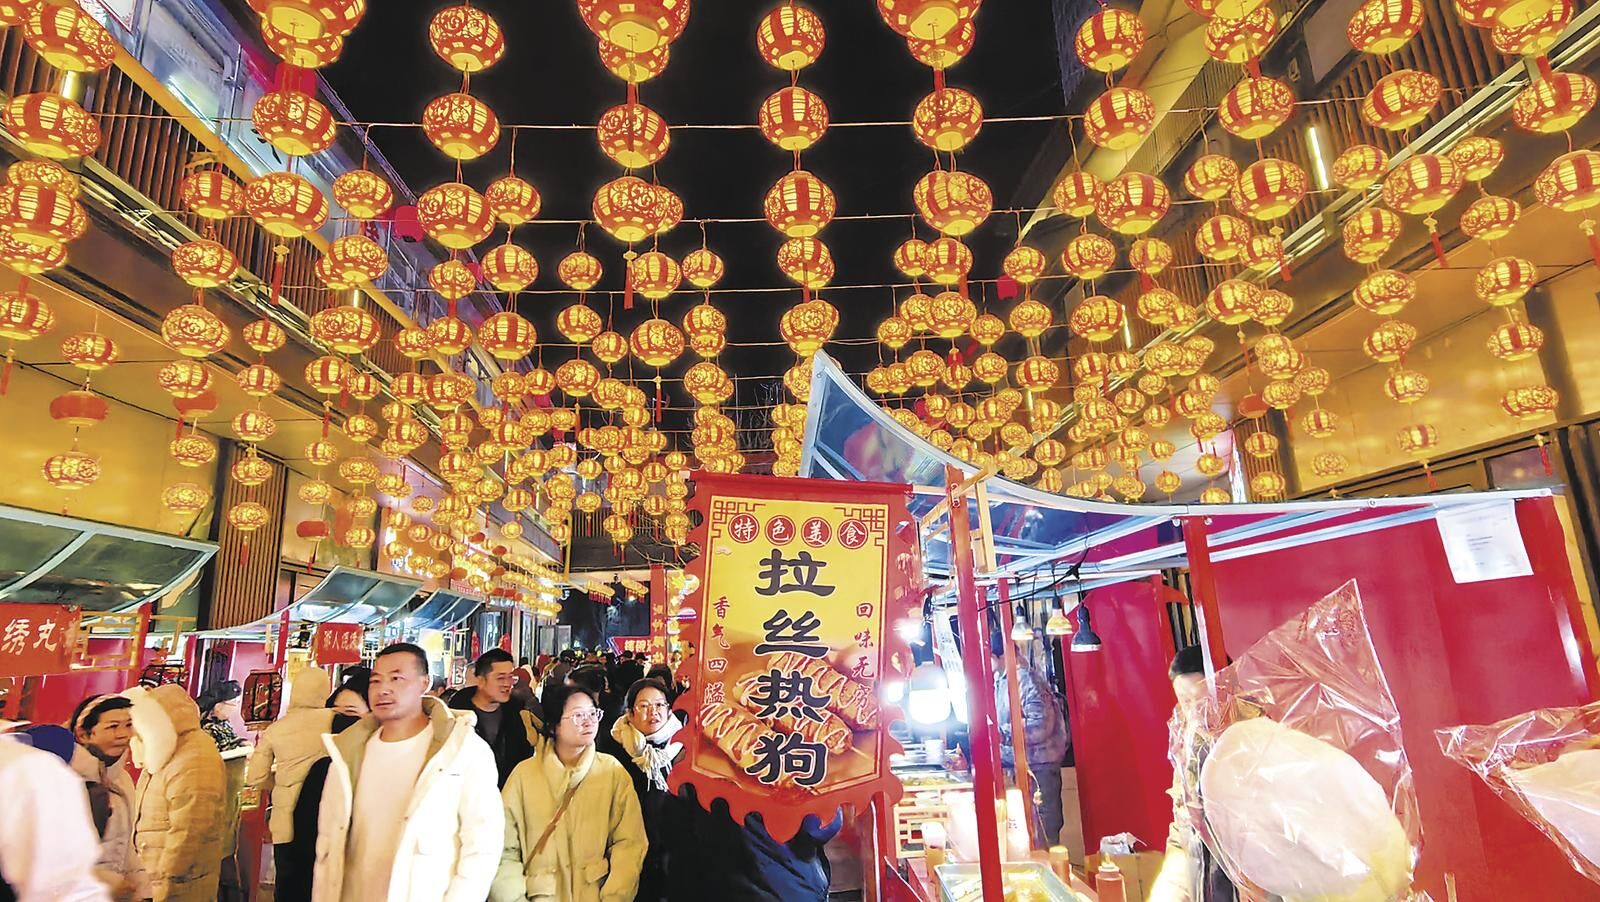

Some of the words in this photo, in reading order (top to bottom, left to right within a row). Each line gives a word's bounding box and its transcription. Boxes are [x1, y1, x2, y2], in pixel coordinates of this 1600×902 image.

[734, 518, 865, 546] 特色美食
[704, 596, 731, 704] 香气四溢
[745, 548, 836, 786] 拉丝热狗
[851, 602, 875, 709] 回味无穷
